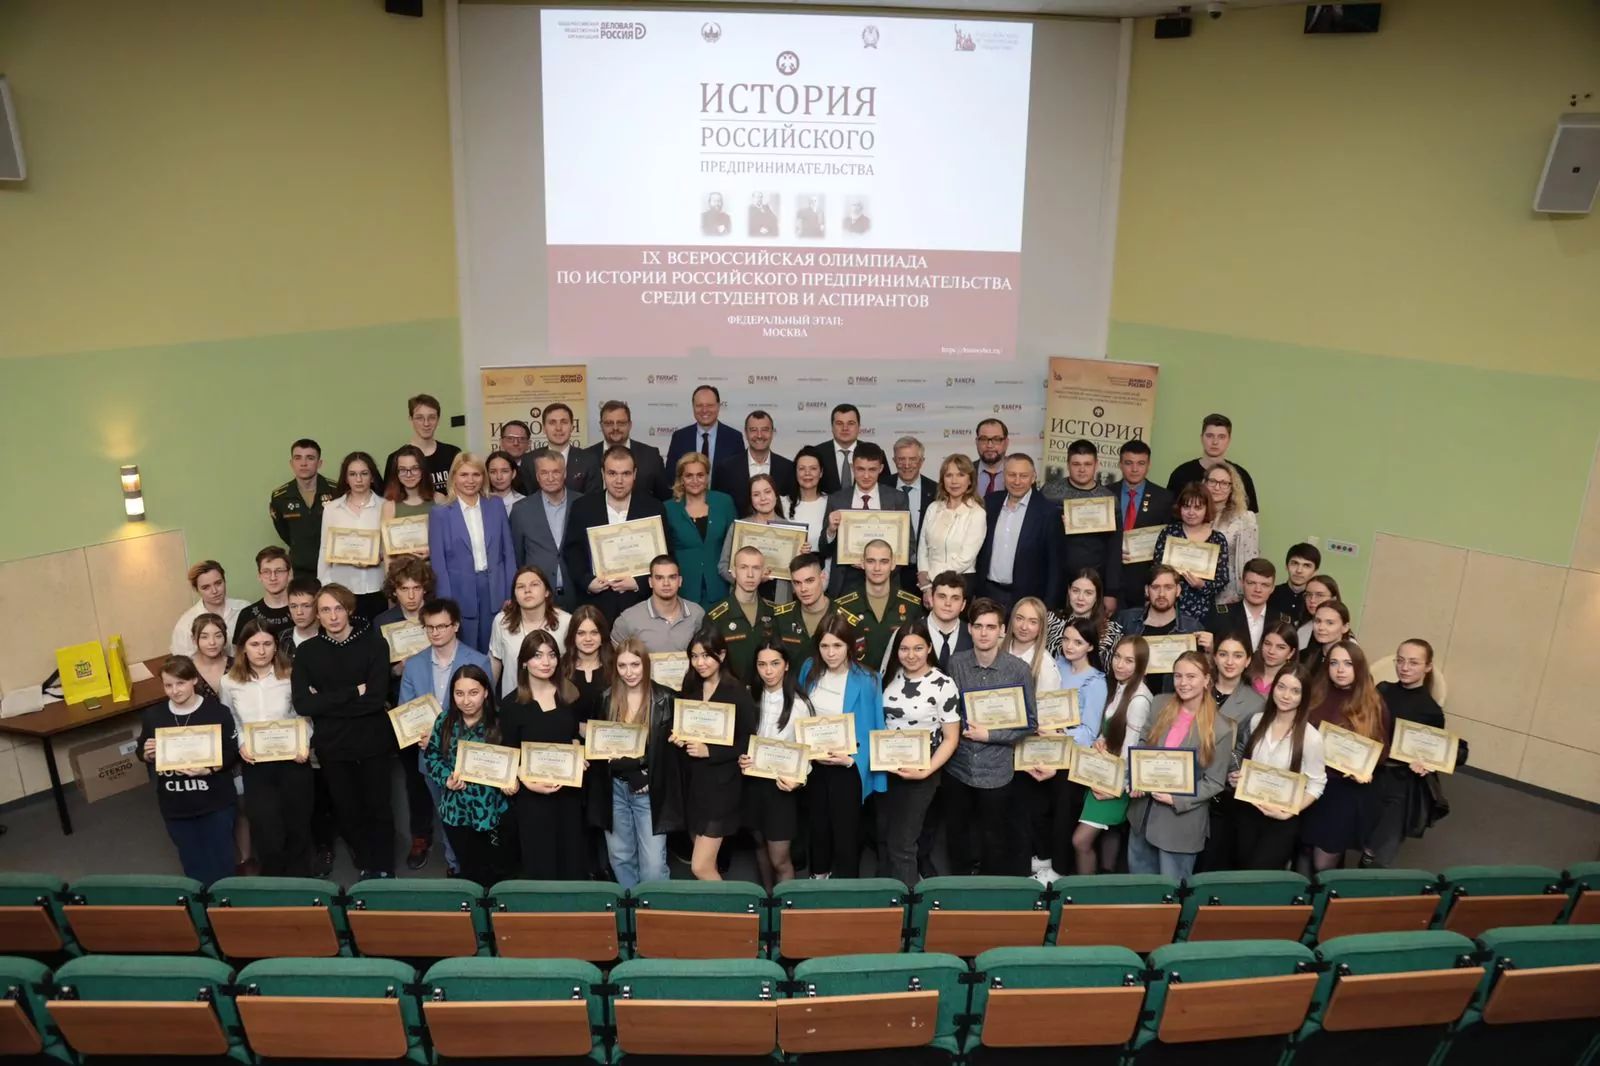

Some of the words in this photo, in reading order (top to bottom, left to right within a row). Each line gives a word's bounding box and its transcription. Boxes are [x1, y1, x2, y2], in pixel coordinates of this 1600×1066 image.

[600, 22, 634, 30] ДЕЛОВАЯ
[600, 30, 634, 40] РОССИЯ
[700, 82, 877, 117] ИСТОРИЯ
[701, 123, 875, 150] РОССИЙСКОГО
[700, 160, 875, 176] ПРЕДПРИНИМАТЕЛЬСТВА
[642, 251, 661, 265] IX
[667, 250, 815, 266] ВСЕРОССИЙСКАЯ
[819, 253, 928, 269] ОЛИМПИАДА
[557, 271, 581, 284] ПО
[585, 271, 667, 285] ИСТОРИИ
[672, 269, 798, 287] РОССИЙСКОГО
[801, 272, 1012, 290] ПРЕДПРИНИМАТЕЛЬСТВА
[641, 291, 696, 306] СРЕДИ
[700, 291, 799, 306] СТУДЕНТОВ
[803, 293, 814, 306] И
[818, 293, 929, 308] АСПИРАНТОВ
[727, 315, 810, 326] ФЕДЕРАЛЬНЫЙ
[812, 316, 844, 326] ЭТАП:
[763, 328, 808, 337] МОСКВА
[1051, 418, 1144, 441] ИСТОРИЯ
[165, 779, 209, 792] CLUB
